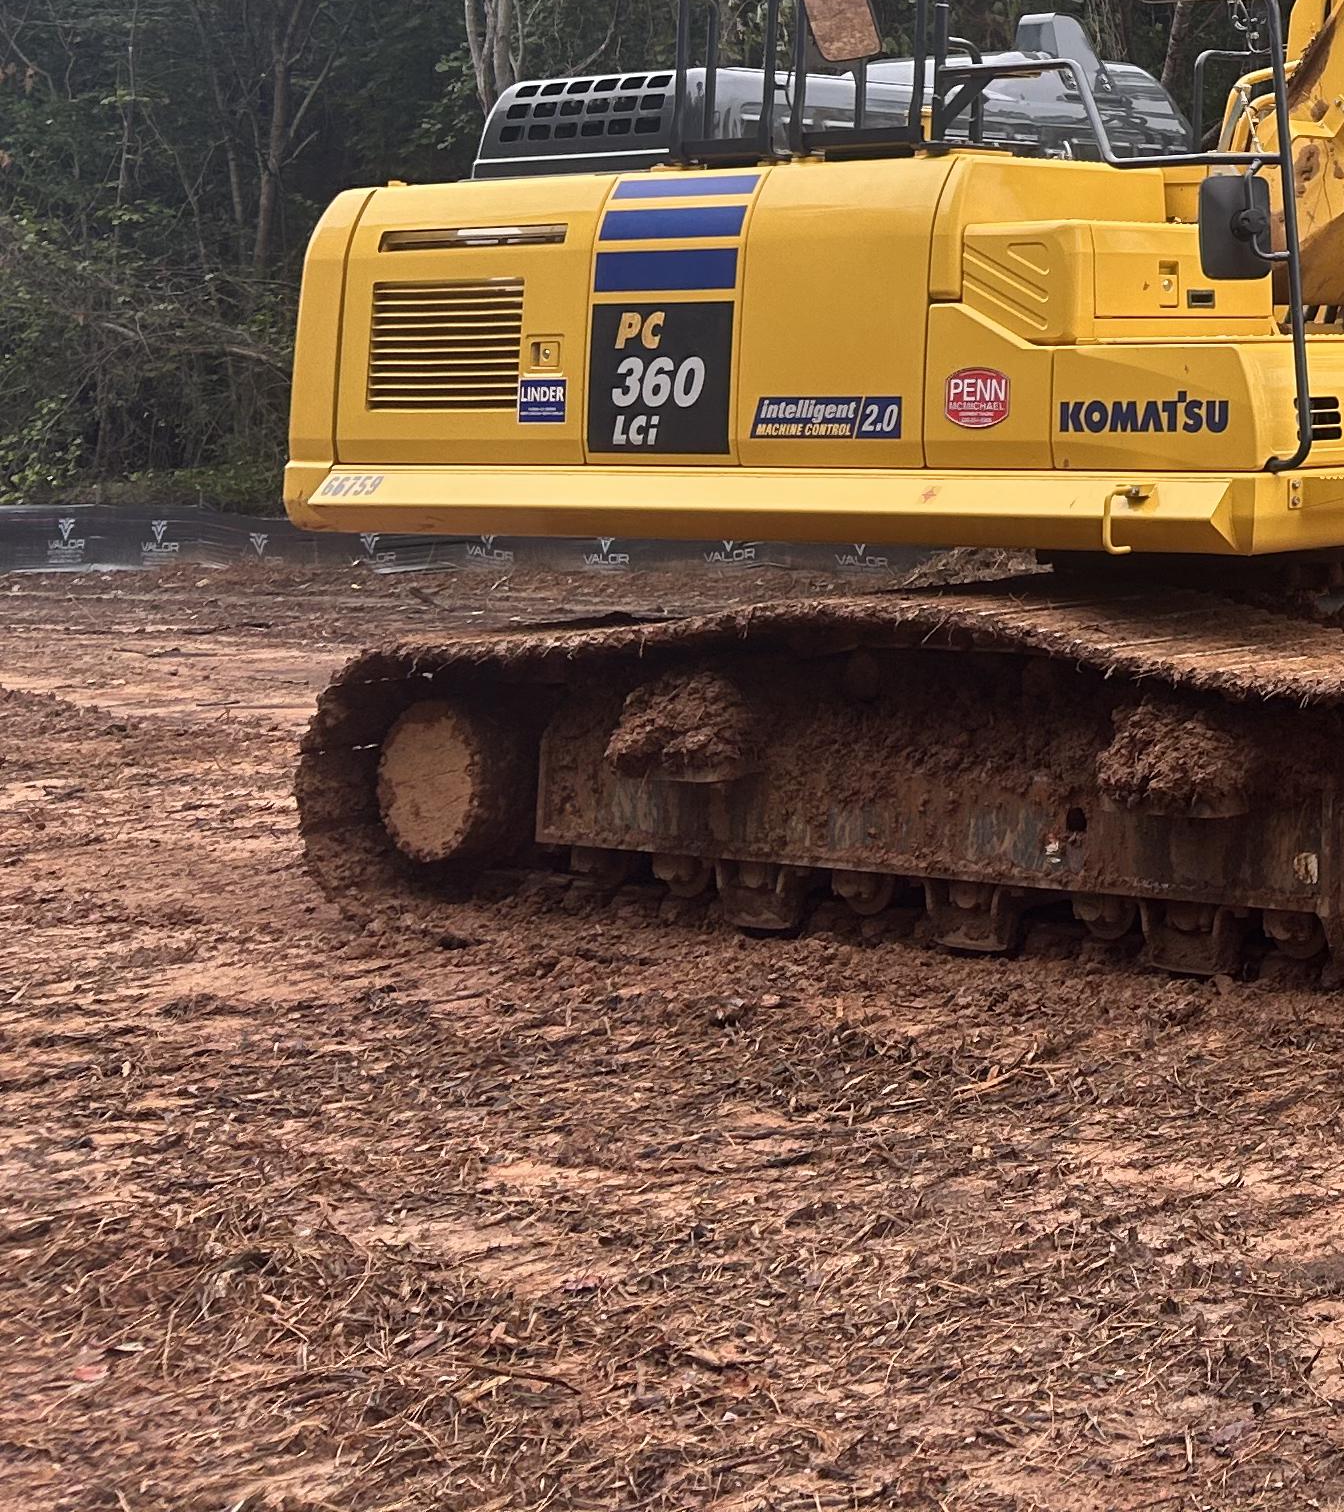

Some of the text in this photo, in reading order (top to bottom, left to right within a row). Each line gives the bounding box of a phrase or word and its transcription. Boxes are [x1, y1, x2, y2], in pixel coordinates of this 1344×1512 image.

[614, 311, 665, 349] PC
[611, 356, 706, 407] 360
[950, 379, 1006, 401] PENN
[520, 386, 565, 402] LINDER
[760, 399, 857, 423] intelligent
[861, 404, 899, 432] 2.0
[1059, 391, 1229, 433] KOMATSU
[612, 415, 660, 445] LCi
[755, 423, 851, 436] MACHINE CONTROL
[320, 476, 384, 497] 66759
[141, 542, 180, 553] VALOR
[465, 544, 514, 562] VALOR
[704, 548, 756, 563] VALOR
[583, 553, 630, 565] VALOR
[835, 553, 889, 568] VALOR
